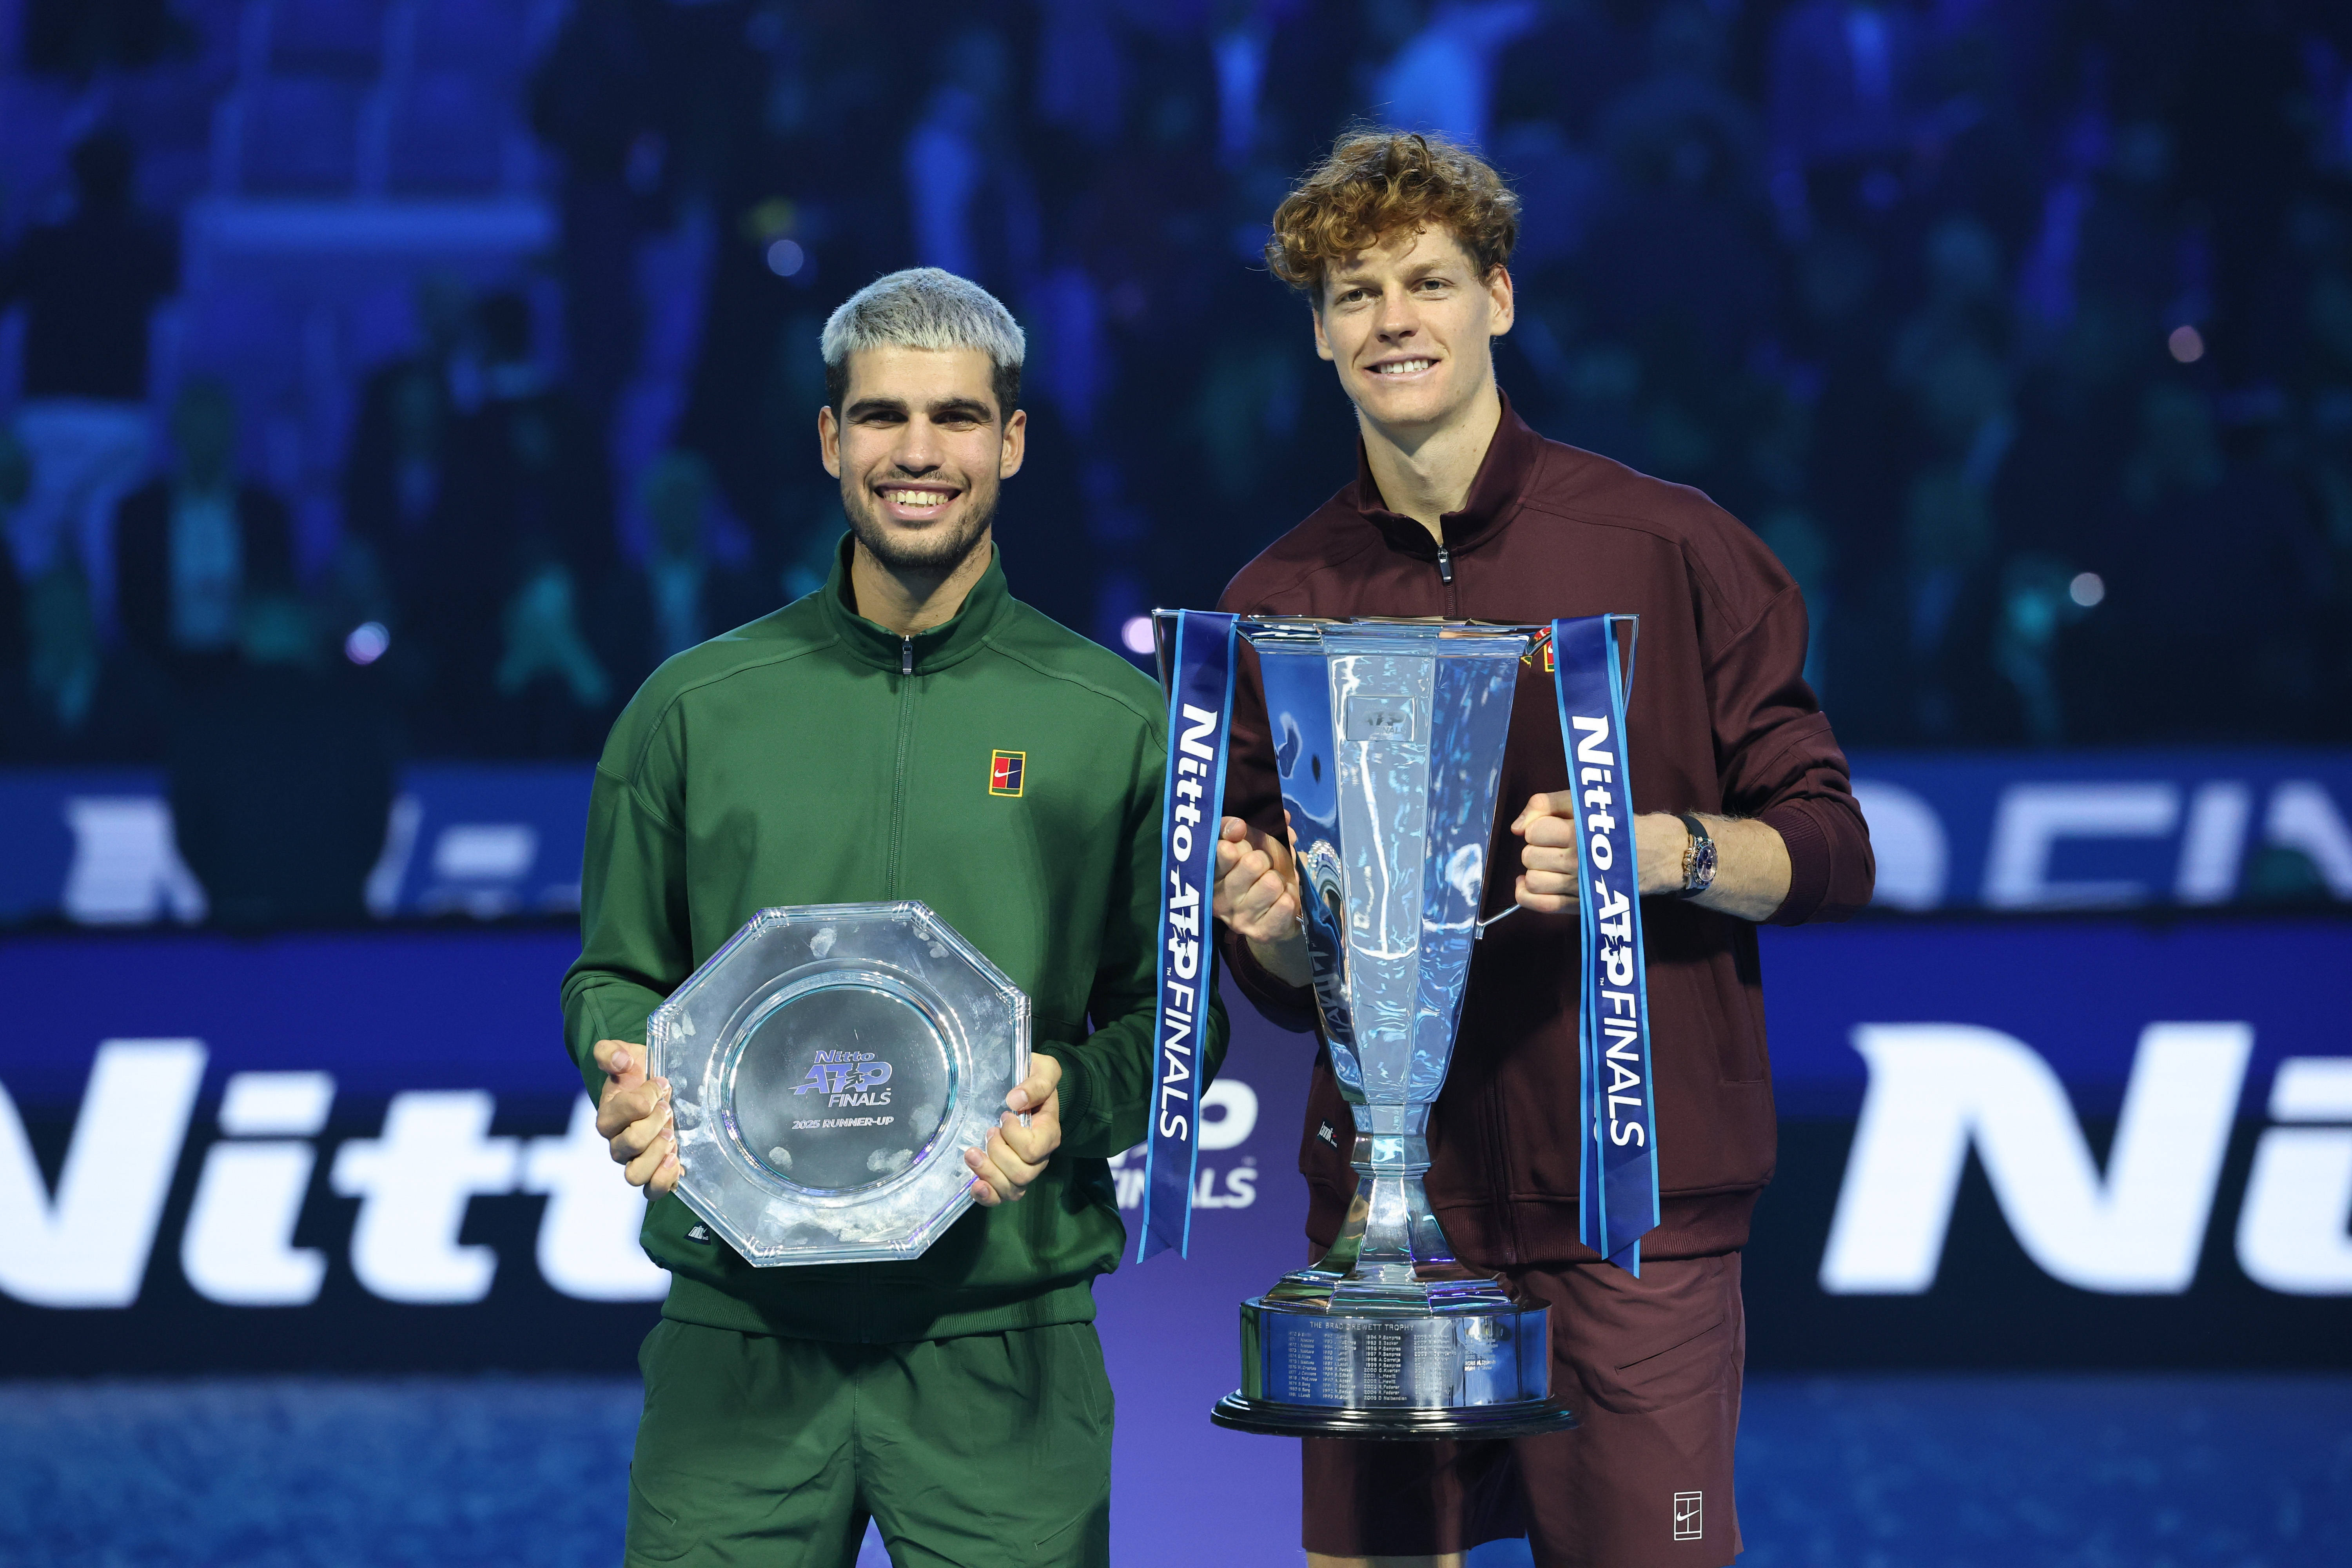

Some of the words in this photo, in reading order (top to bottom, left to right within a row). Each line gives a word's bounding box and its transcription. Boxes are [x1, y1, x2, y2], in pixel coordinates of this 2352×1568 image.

[1173, 703, 1218, 862] Nitto
[1572, 715, 1614, 870] Nitto
[1169, 864, 1200, 979] ATP
[1595, 874, 1633, 986] ATP
[788, 1062, 893, 1095] ATP
[814, 1050, 875, 1063] Nitto
[828, 1091, 891, 1107] FINALS
[1160, 980, 1194, 1141] FINALS
[1602, 990, 1644, 1147] FINALS
[792, 1120, 821, 1129] 2025
[822, 1116, 894, 1128] RUNNER-UP
